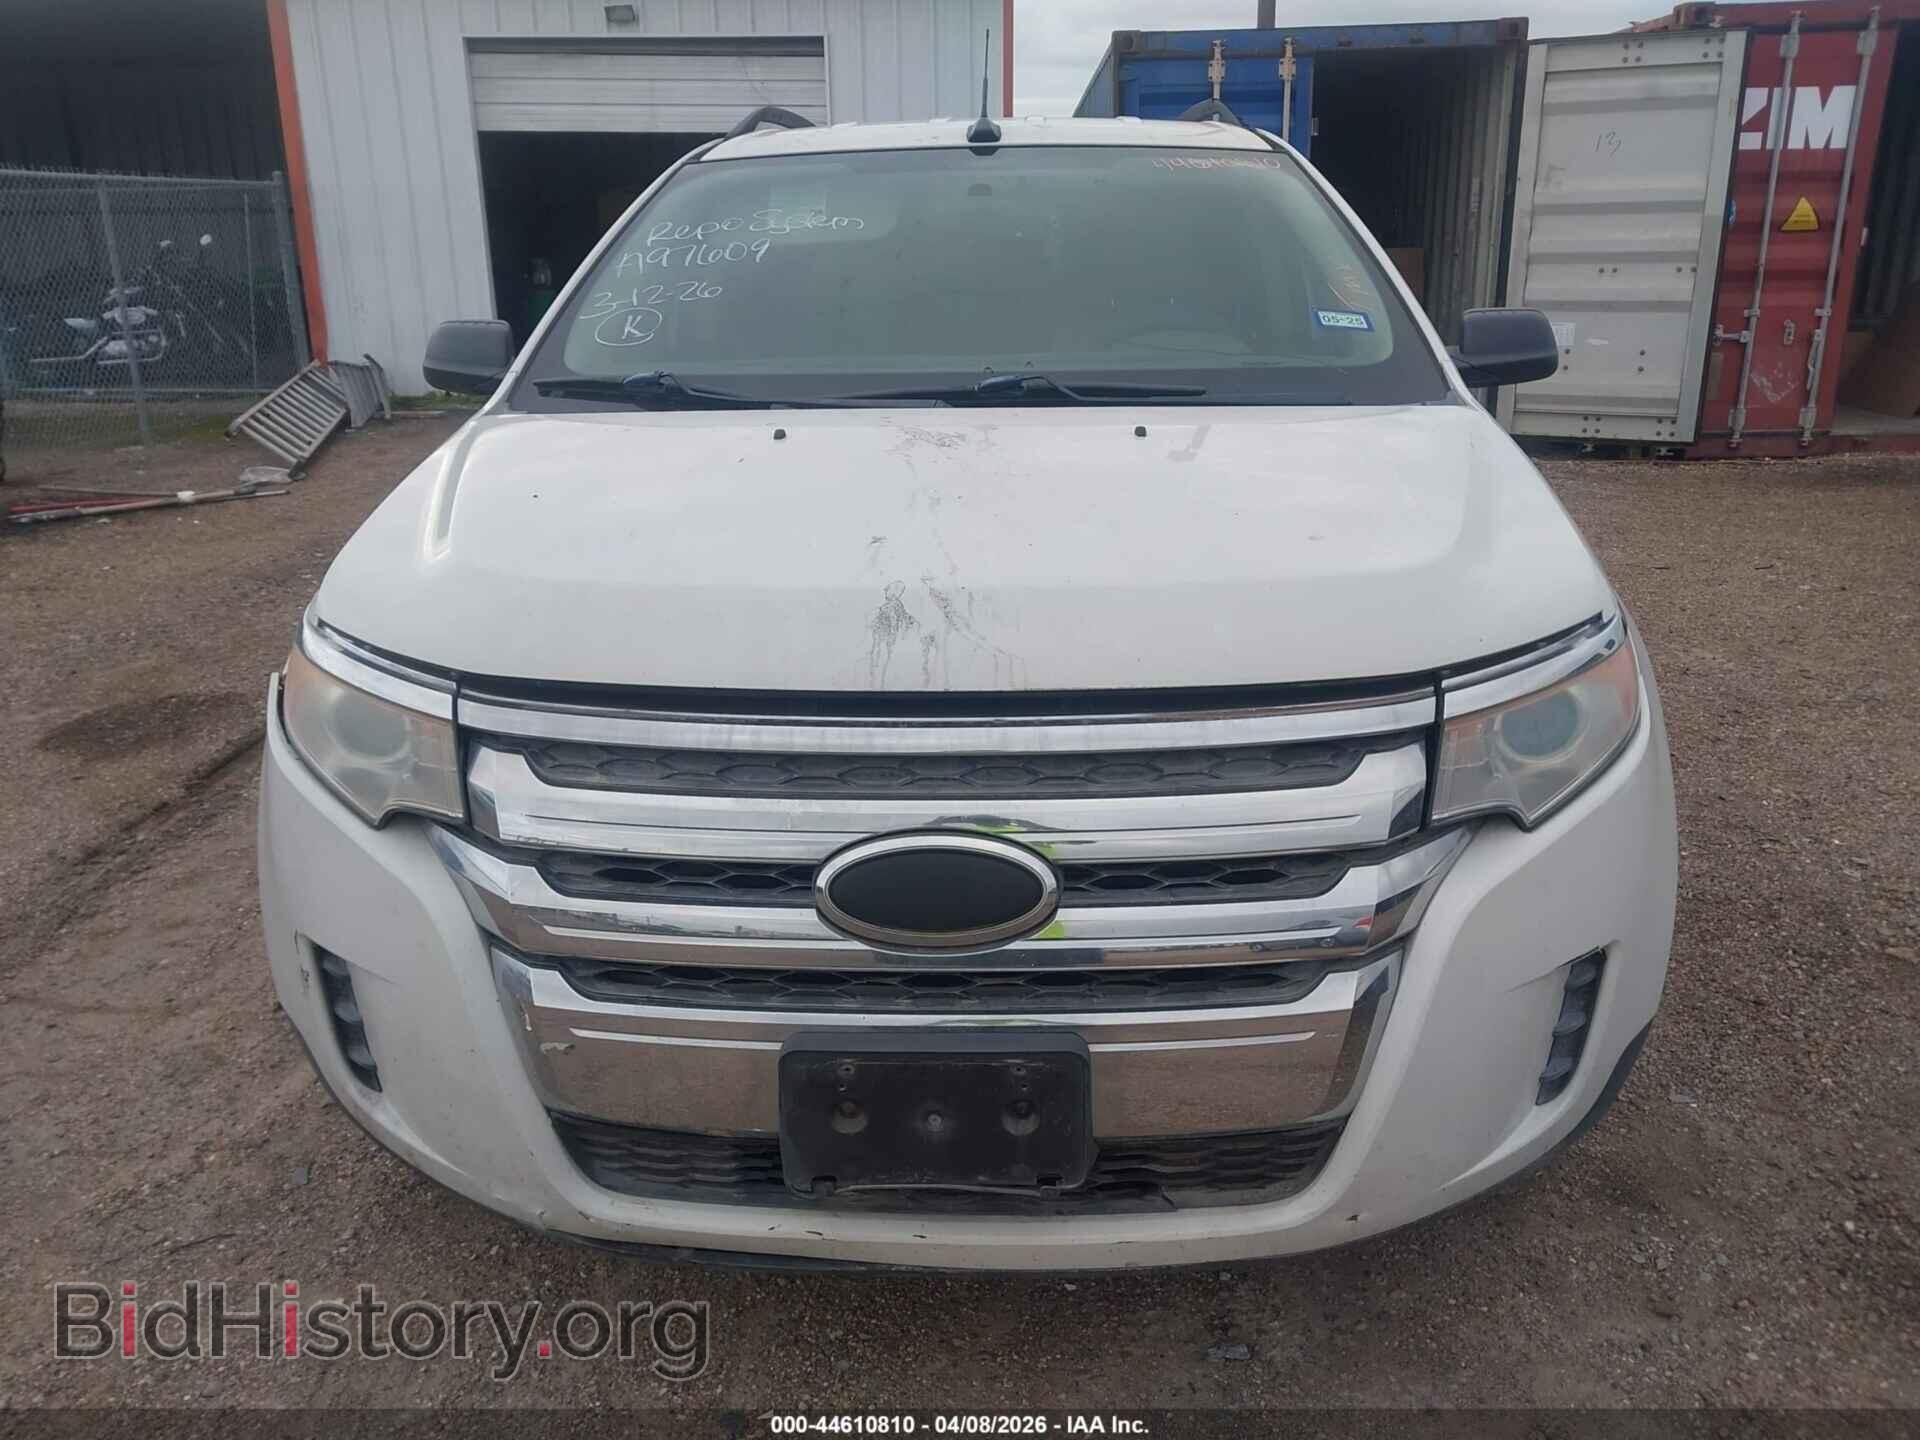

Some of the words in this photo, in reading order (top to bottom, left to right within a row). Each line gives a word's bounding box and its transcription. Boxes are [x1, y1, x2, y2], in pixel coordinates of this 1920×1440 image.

[1739, 85, 1857, 150] ZIM
[647, 217, 744, 247] Repo
[621, 315, 643, 339] K
